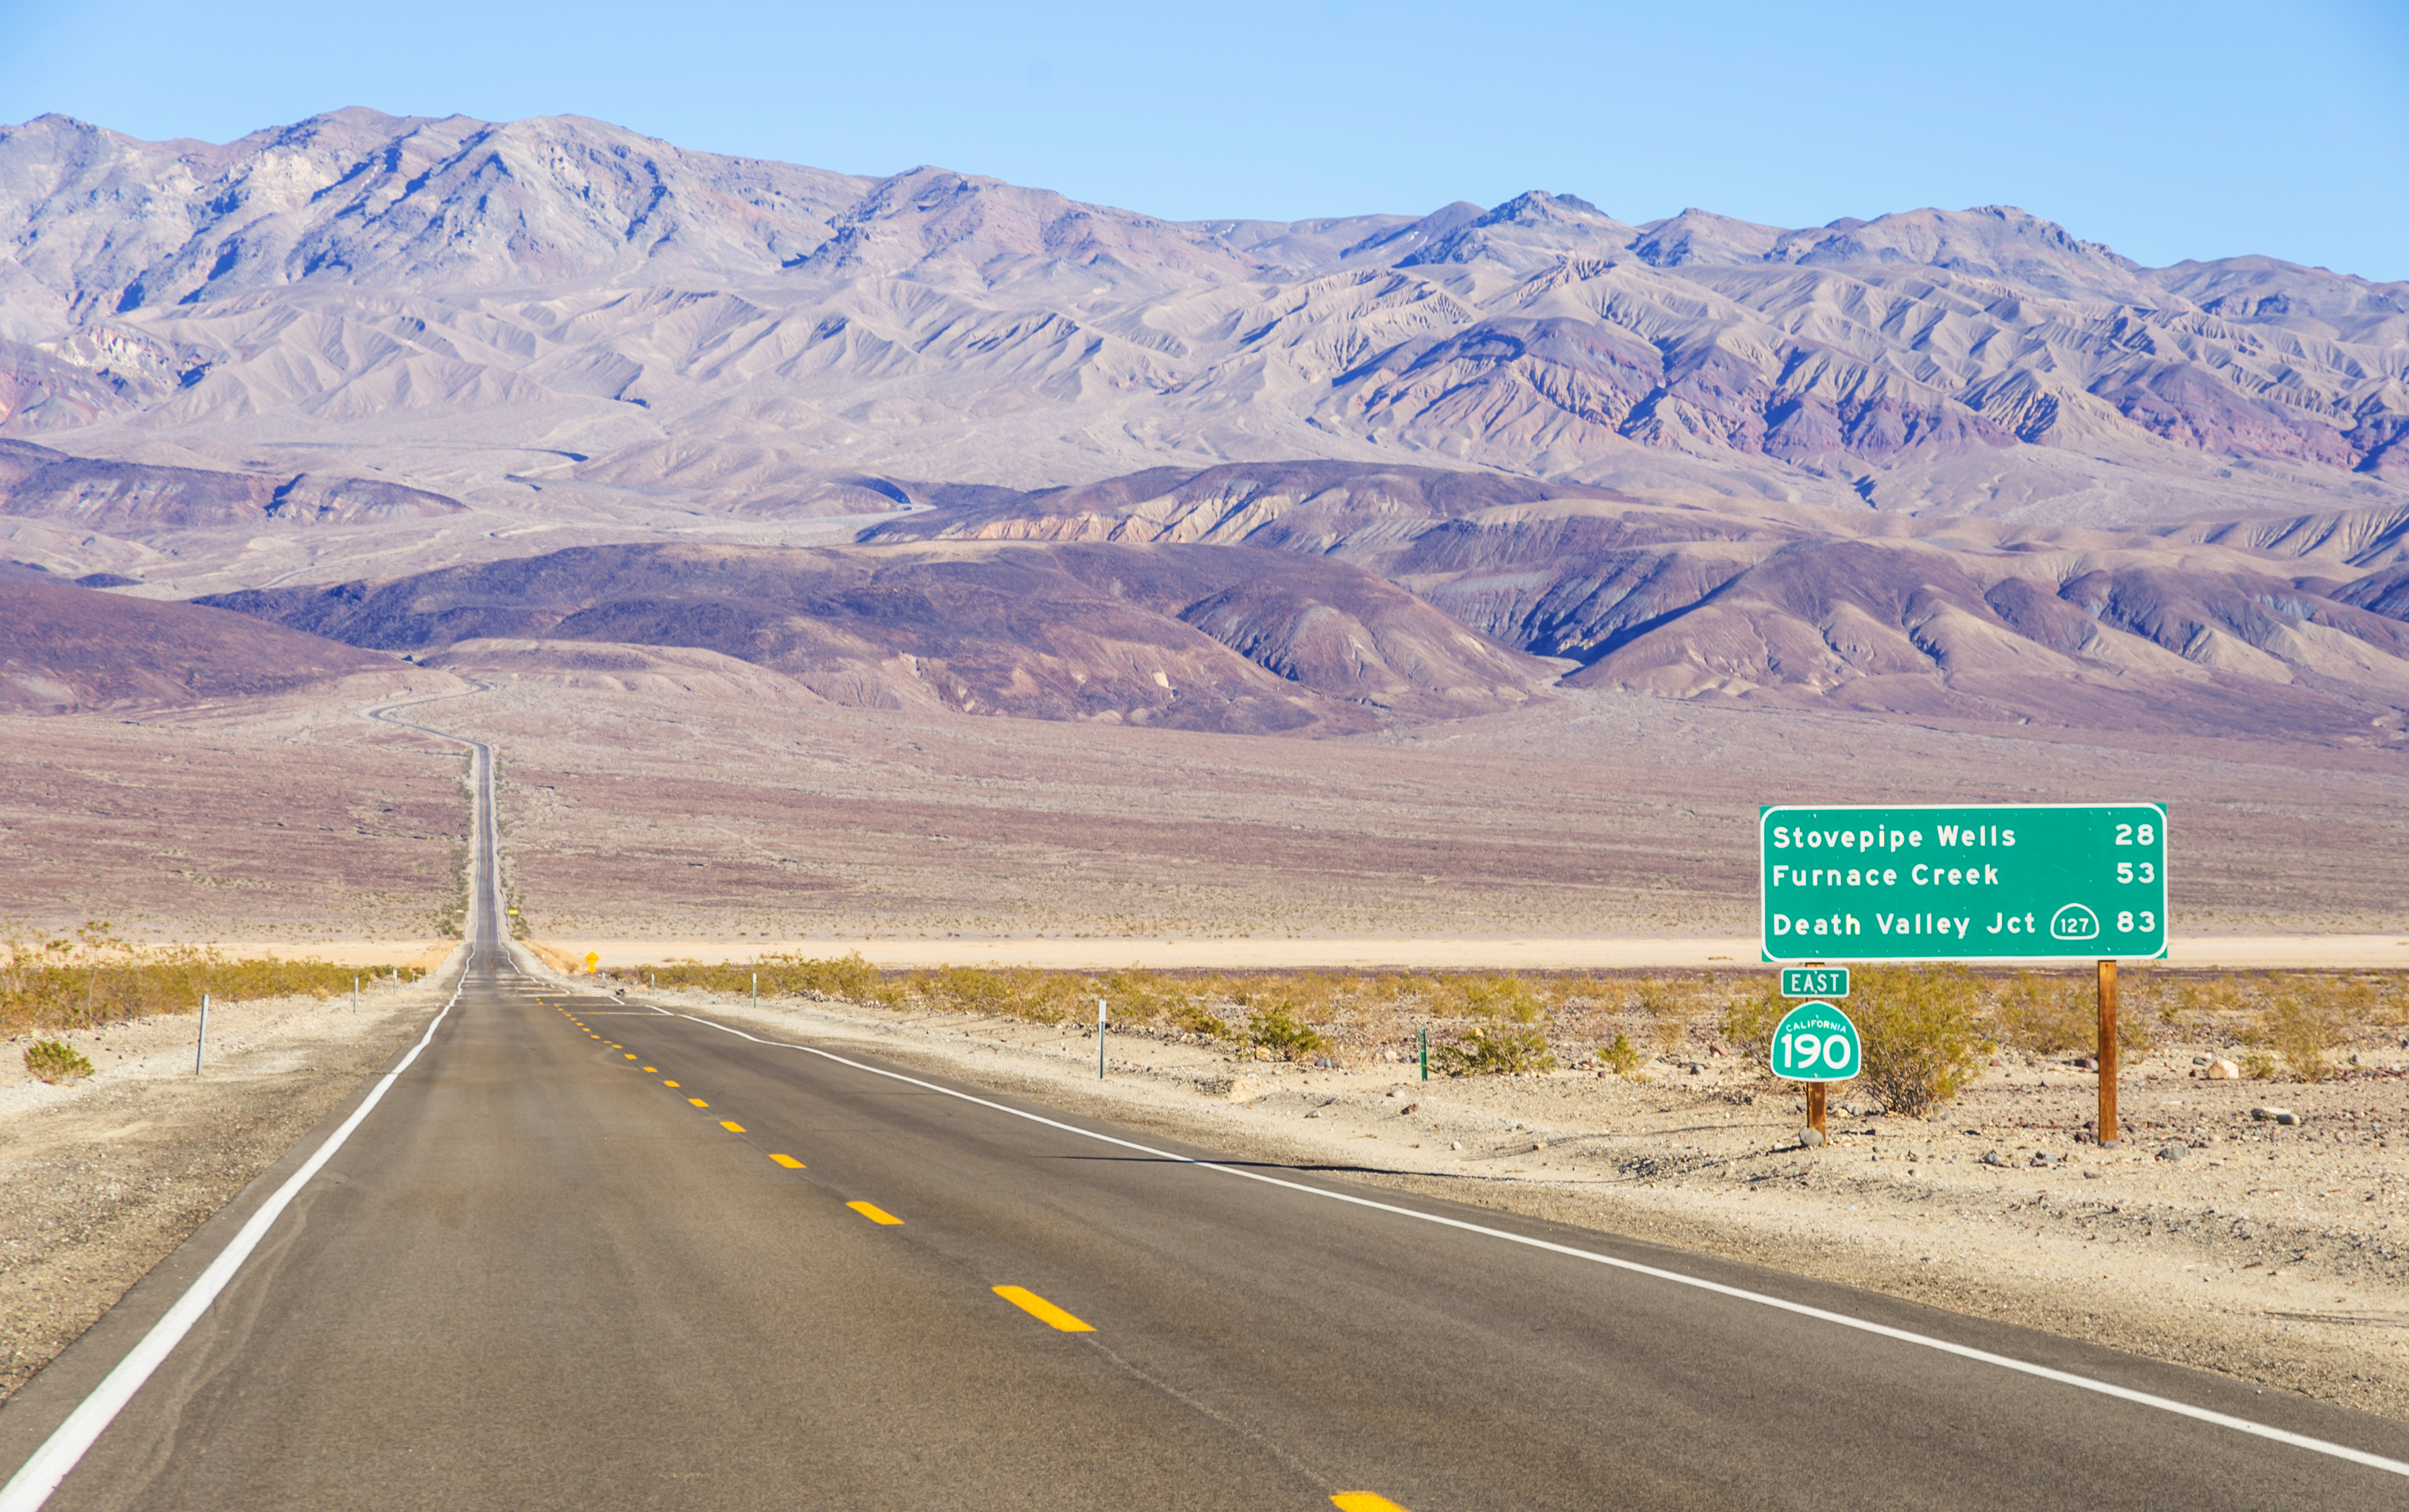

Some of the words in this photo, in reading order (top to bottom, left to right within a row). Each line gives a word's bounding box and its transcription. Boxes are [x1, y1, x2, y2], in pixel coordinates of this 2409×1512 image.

[1774, 825, 1922, 852] Stovepipe
[1938, 825, 2015, 846] Wells
[2116, 824, 2154, 845] 28
[1774, 866, 1897, 886] Furnace
[1912, 864, 1998, 885] Creek
[2117, 862, 2154, 884] 53
[1774, 914, 1860, 935] Death
[1876, 913, 1970, 939] Valley
[1987, 913, 2035, 933] Jct
[2062, 919, 2088, 933] 127
[2117, 911, 2155, 932] 83
[1792, 974, 1839, 992] EAST
[1787, 1020, 1846, 1033] CALIFORNIA
[1781, 1034, 1850, 1069] 190
